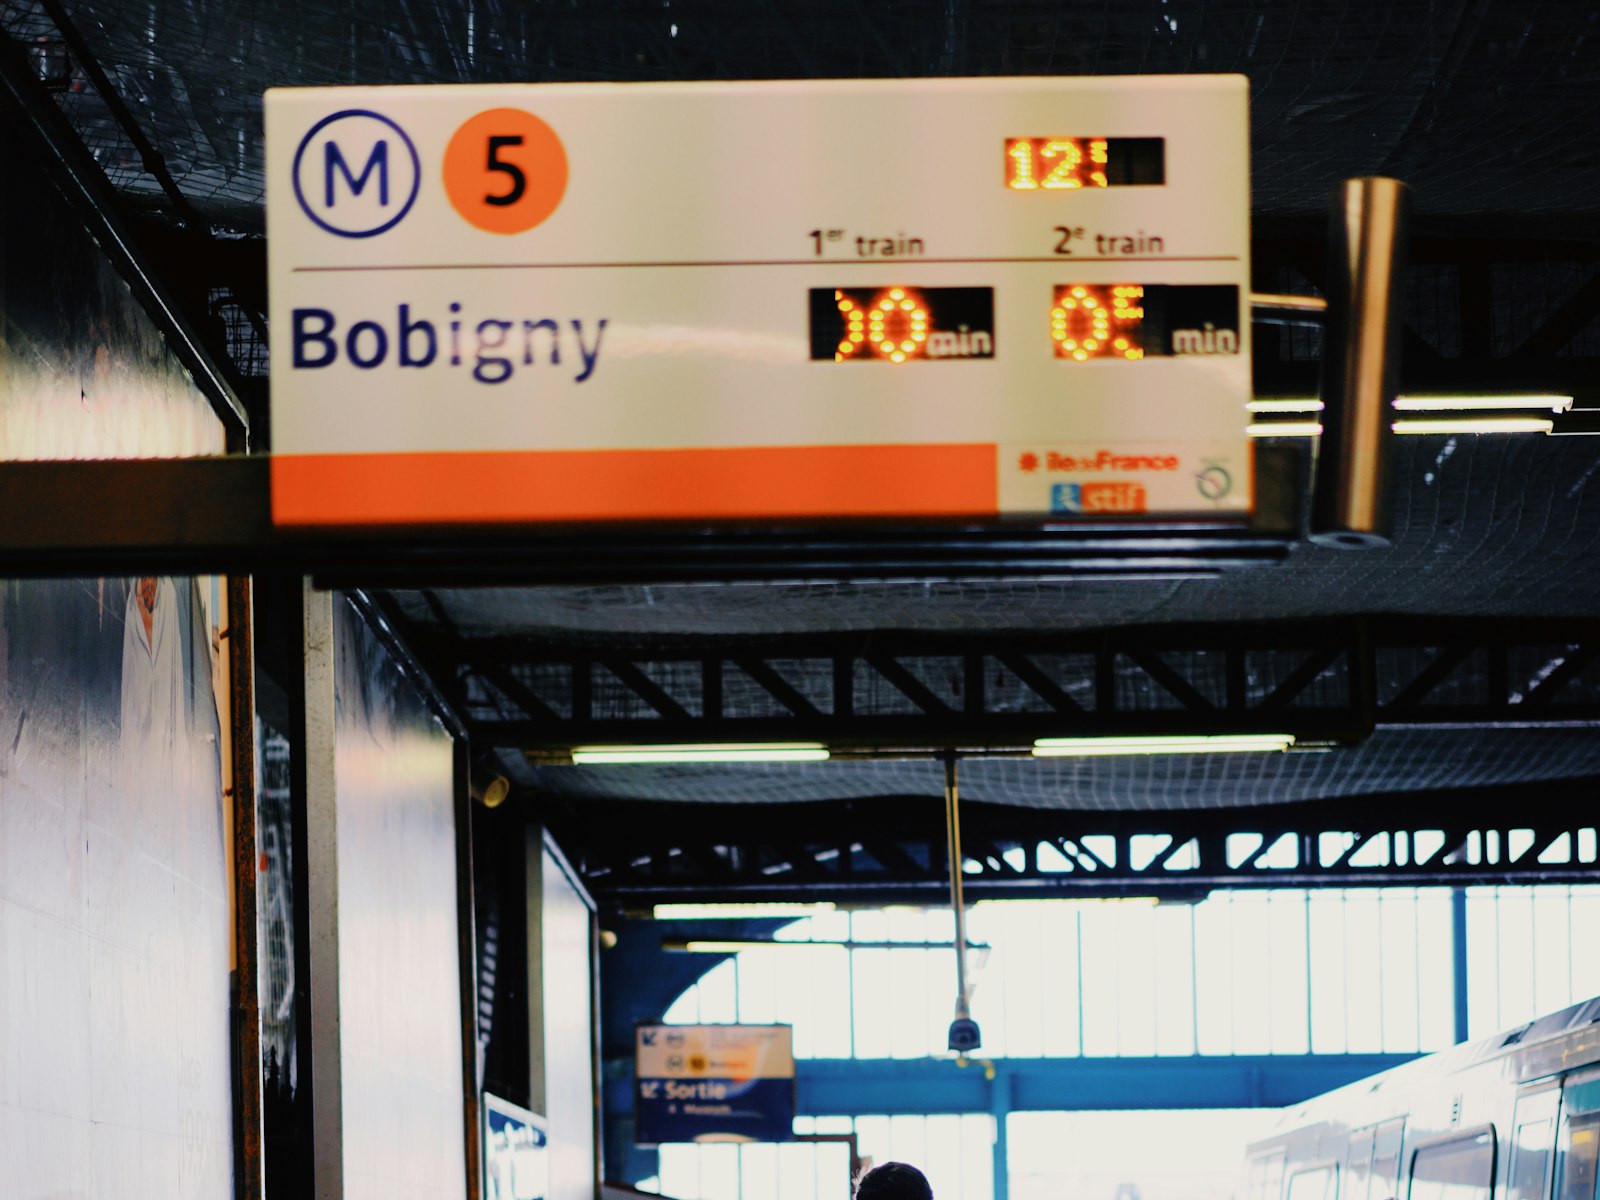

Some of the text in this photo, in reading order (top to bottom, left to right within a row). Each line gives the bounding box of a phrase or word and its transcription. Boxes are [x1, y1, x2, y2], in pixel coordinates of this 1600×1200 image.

[323, 134, 528, 208] M 5
[856, 231, 925, 257] train
[1096, 230, 1164, 255] train
[290, 302, 609, 386] Bobigny
[926, 324, 992, 357] min
[1172, 322, 1238, 356] min
[664, 1080, 728, 1100] Sortie
